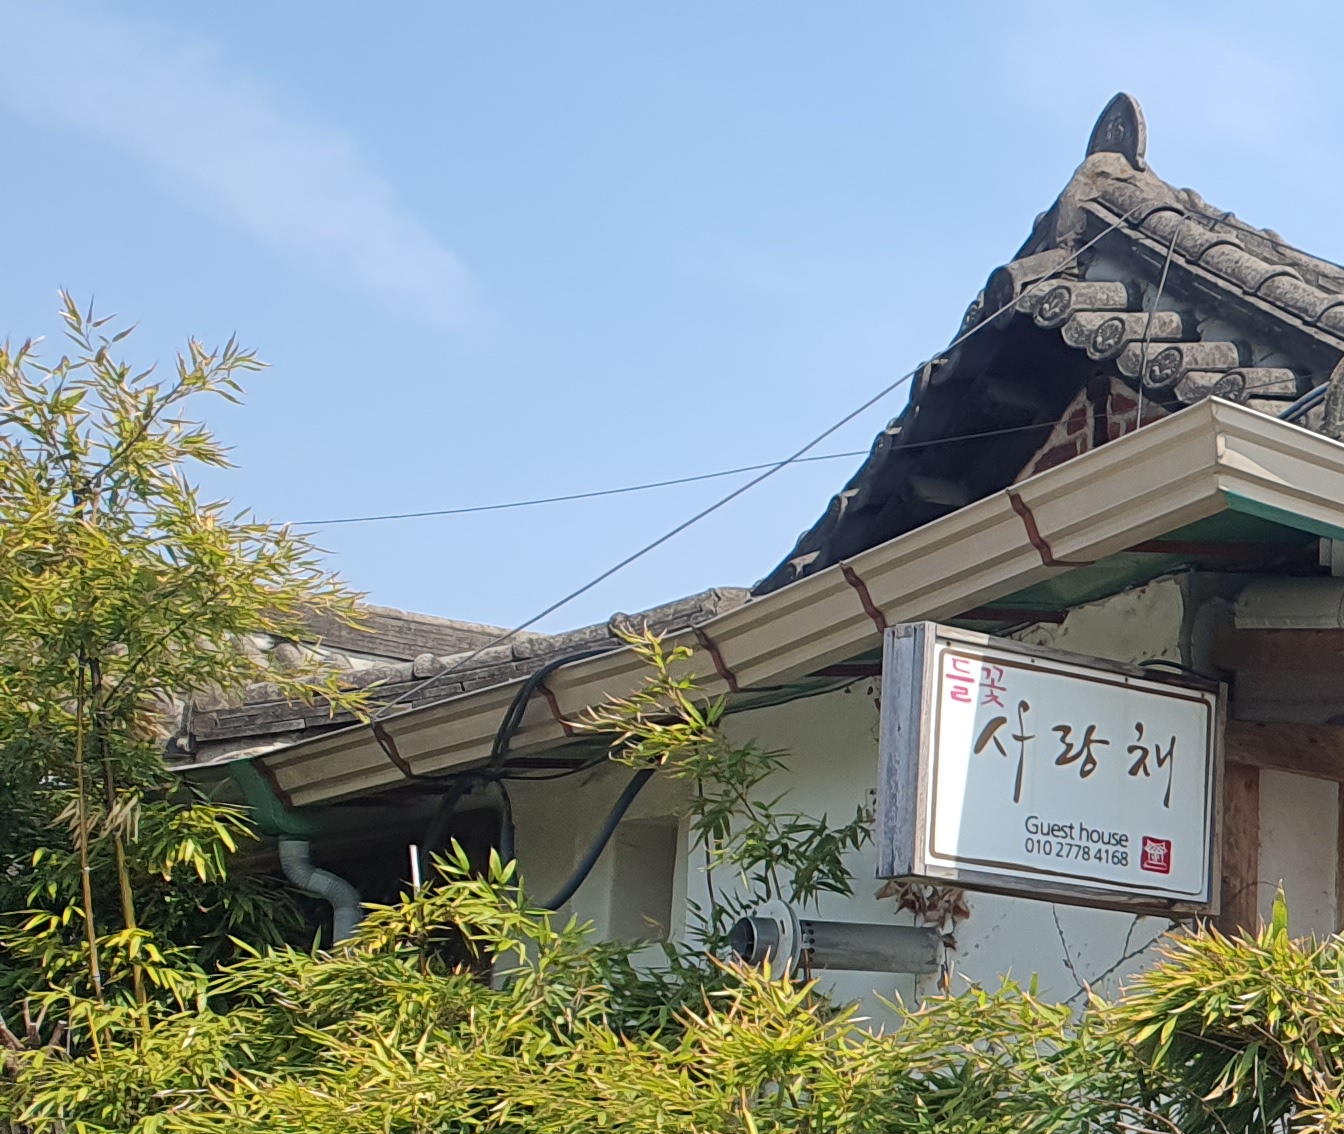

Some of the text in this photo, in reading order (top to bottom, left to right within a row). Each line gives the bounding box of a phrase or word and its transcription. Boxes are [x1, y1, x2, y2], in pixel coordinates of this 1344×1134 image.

[946, 657, 1007, 709] 들꽃
[973, 700, 1177, 809] 사랑채
[1024, 815, 1130, 848] Guest house
[1024, 837, 1129, 867] 010 2778 4168
